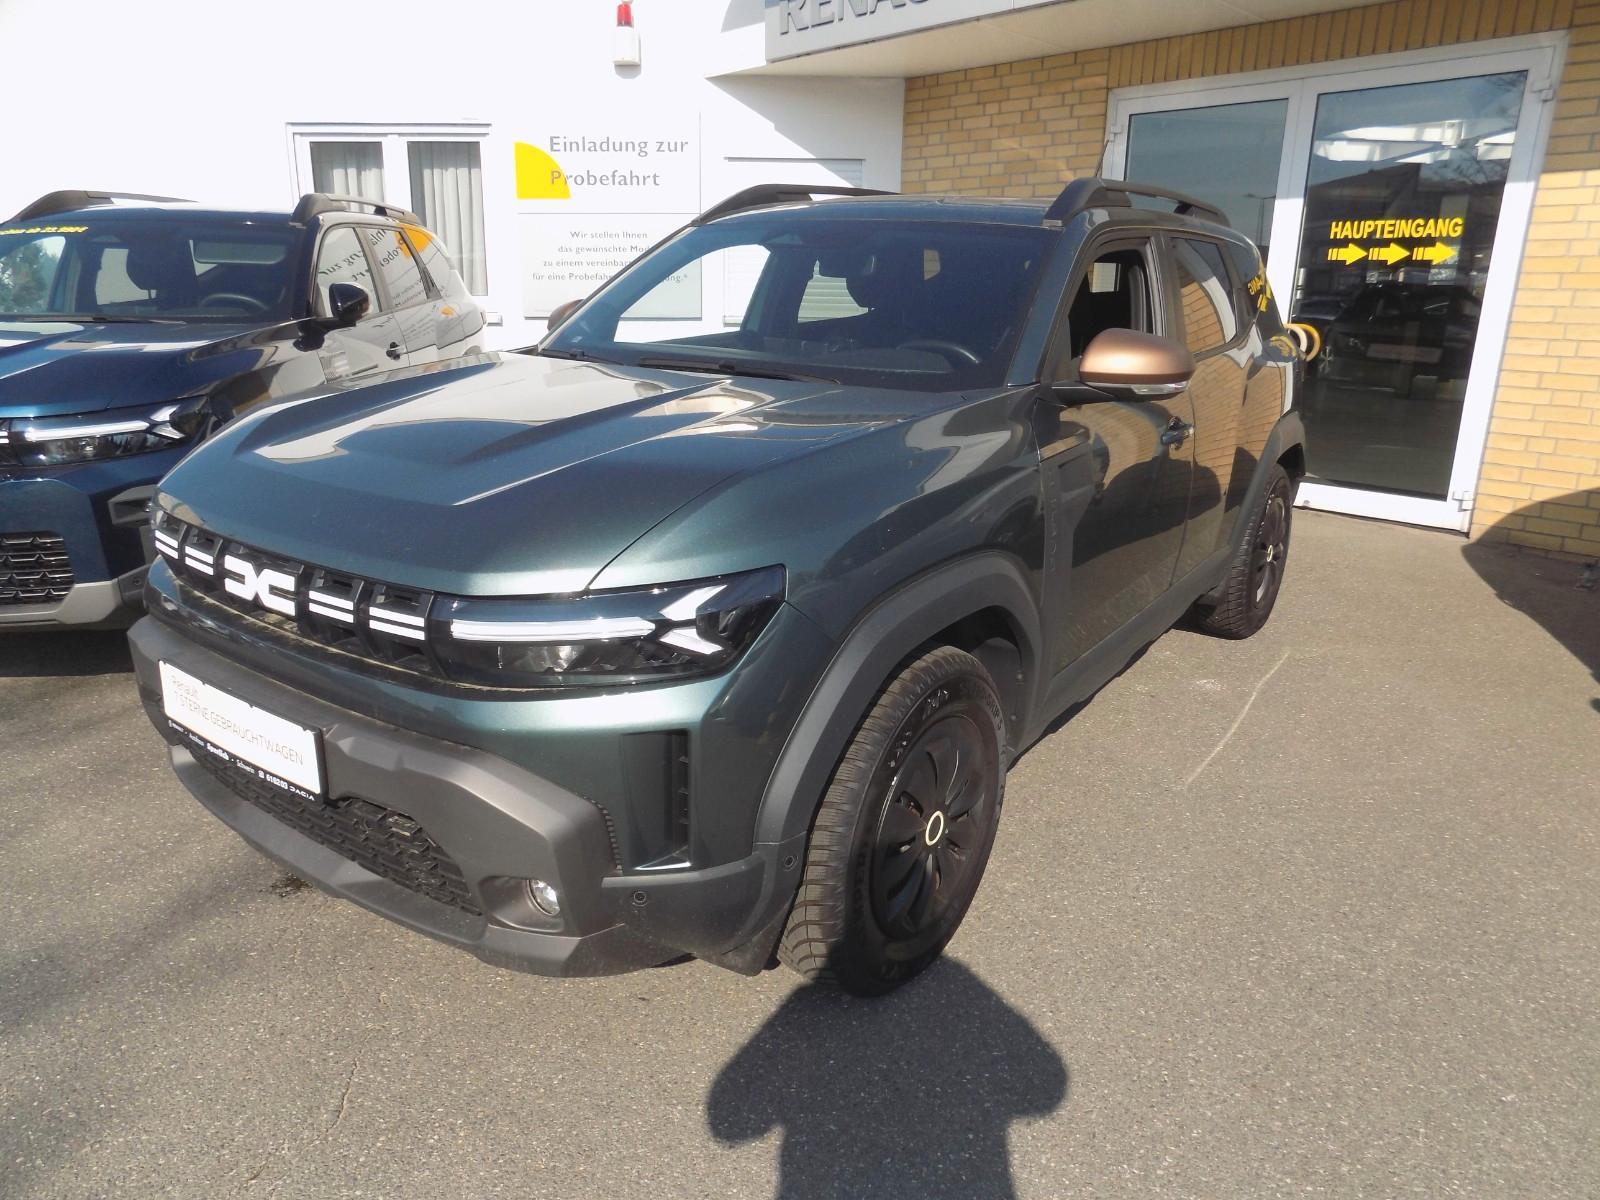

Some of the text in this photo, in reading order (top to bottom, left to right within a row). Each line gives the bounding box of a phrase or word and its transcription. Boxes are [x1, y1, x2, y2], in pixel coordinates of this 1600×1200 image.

[549, 136, 689, 158] Einladung zur
[551, 169, 661, 186] Probefahrt
[1329, 216, 1464, 239] HAUPTEINGANG
[569, 231, 648, 239] Wir stellen Ihnen
[558, 244, 573, 253] das
[630, 244, 651, 253] Mod
[556, 259, 584, 267] einem
[547, 272, 566, 281] eine
